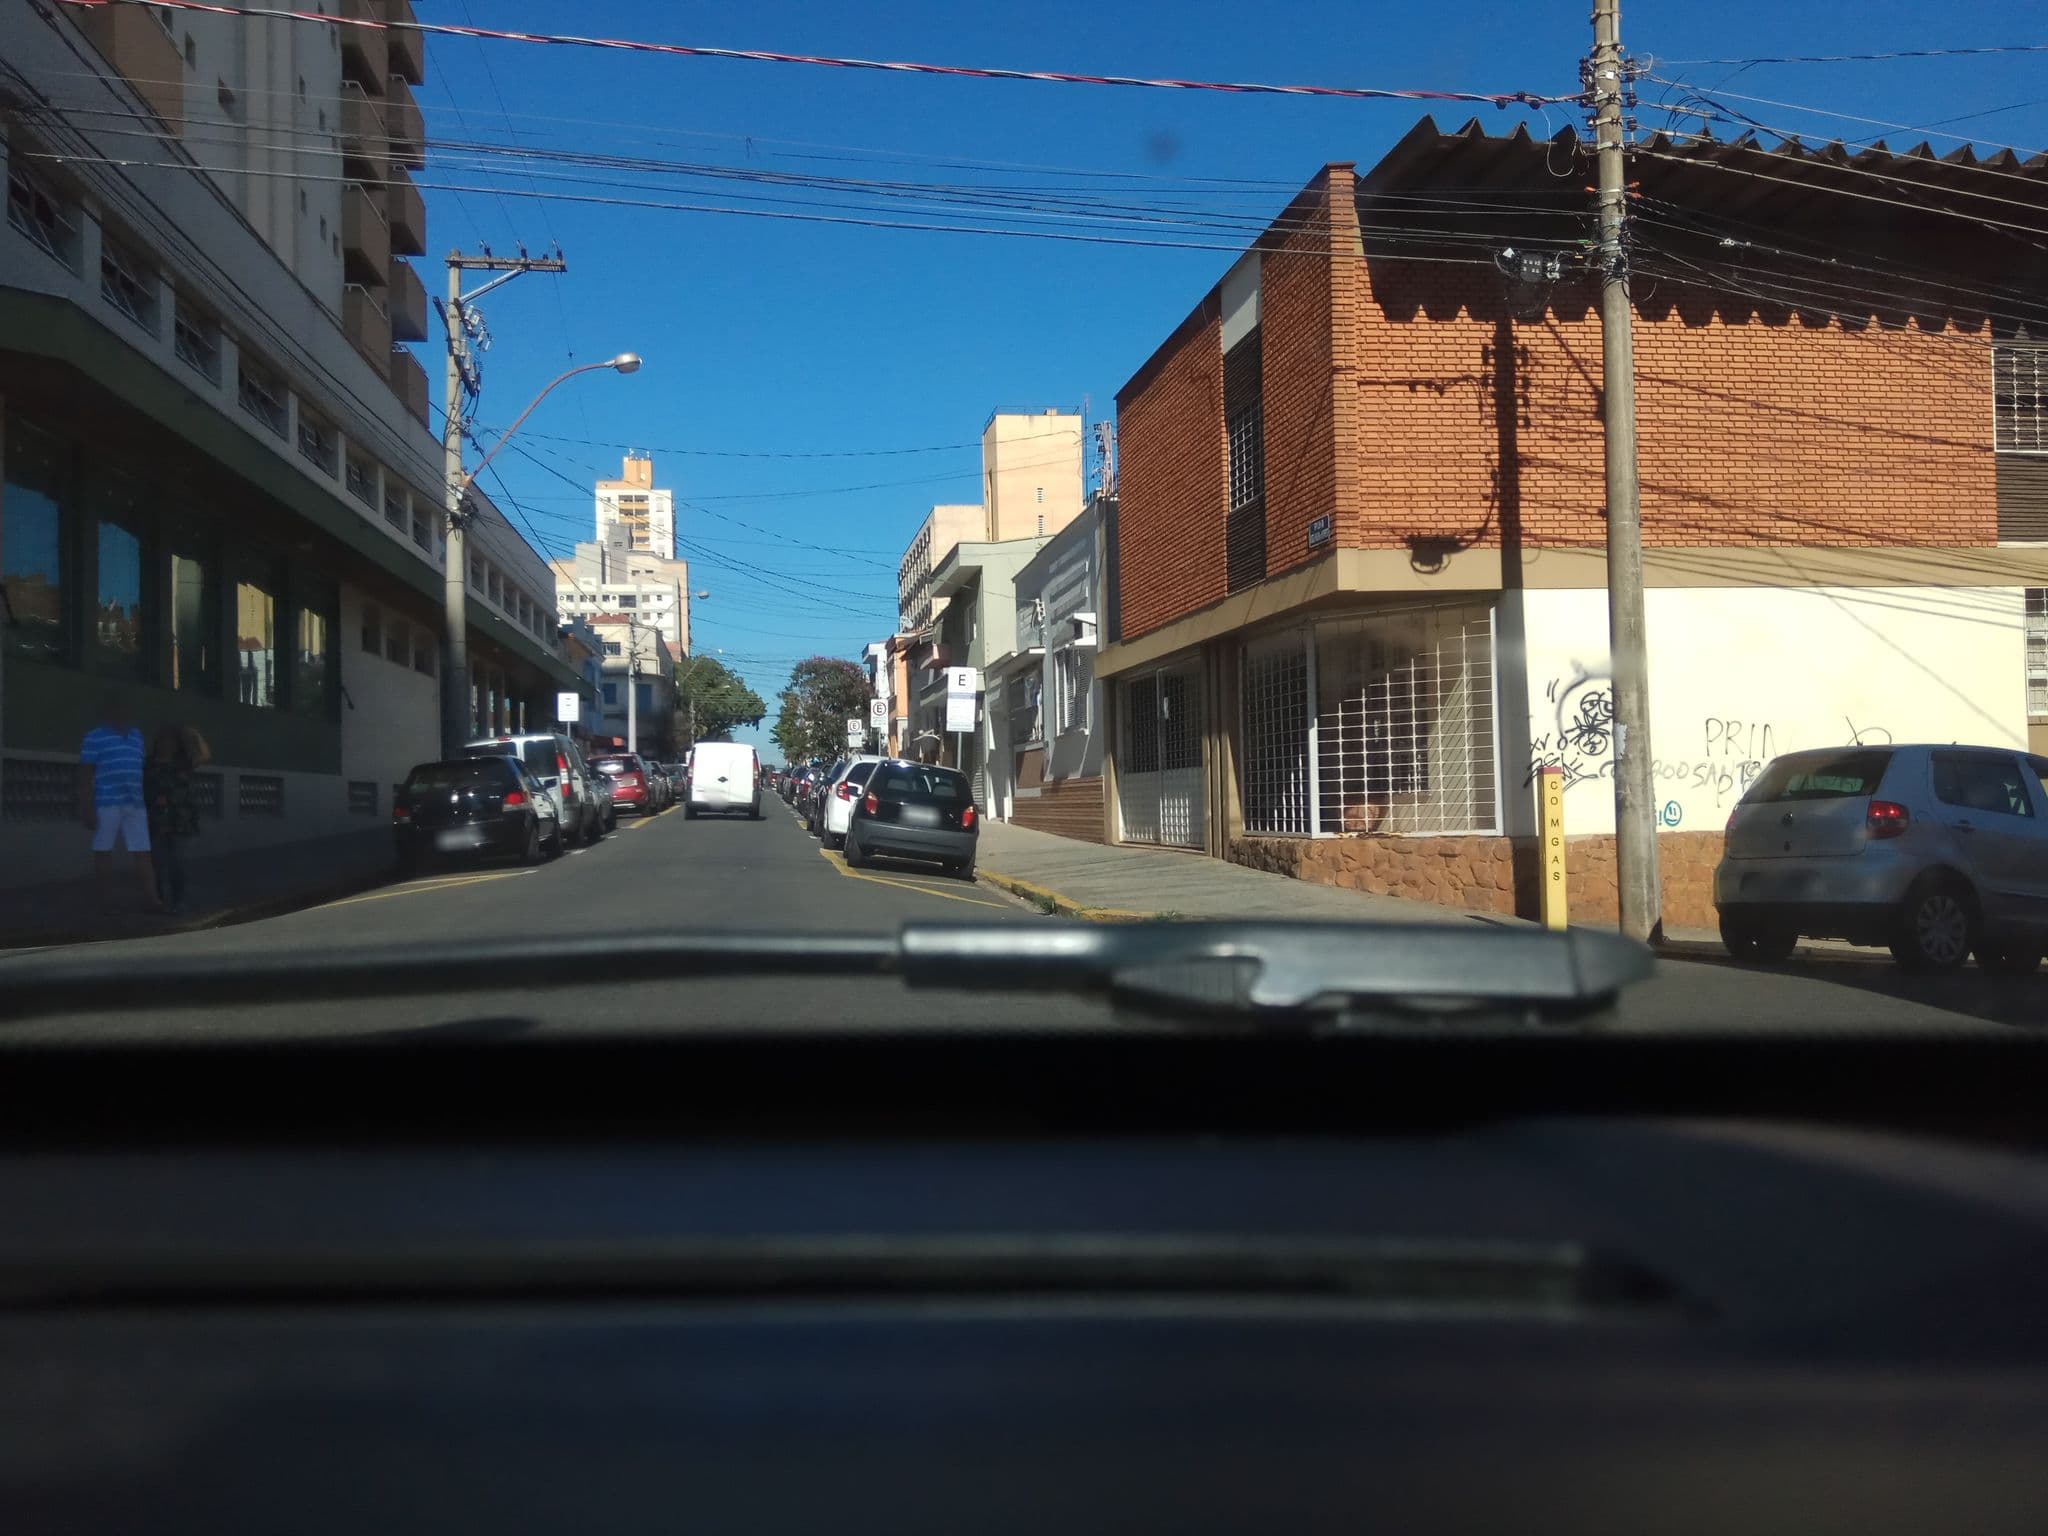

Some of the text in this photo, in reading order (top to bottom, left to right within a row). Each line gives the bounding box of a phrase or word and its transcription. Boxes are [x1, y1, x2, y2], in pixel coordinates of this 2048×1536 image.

[958, 674, 967, 687] E
[876, 704, 883, 713] E
[1550, 781, 1561, 881] COMGAS
